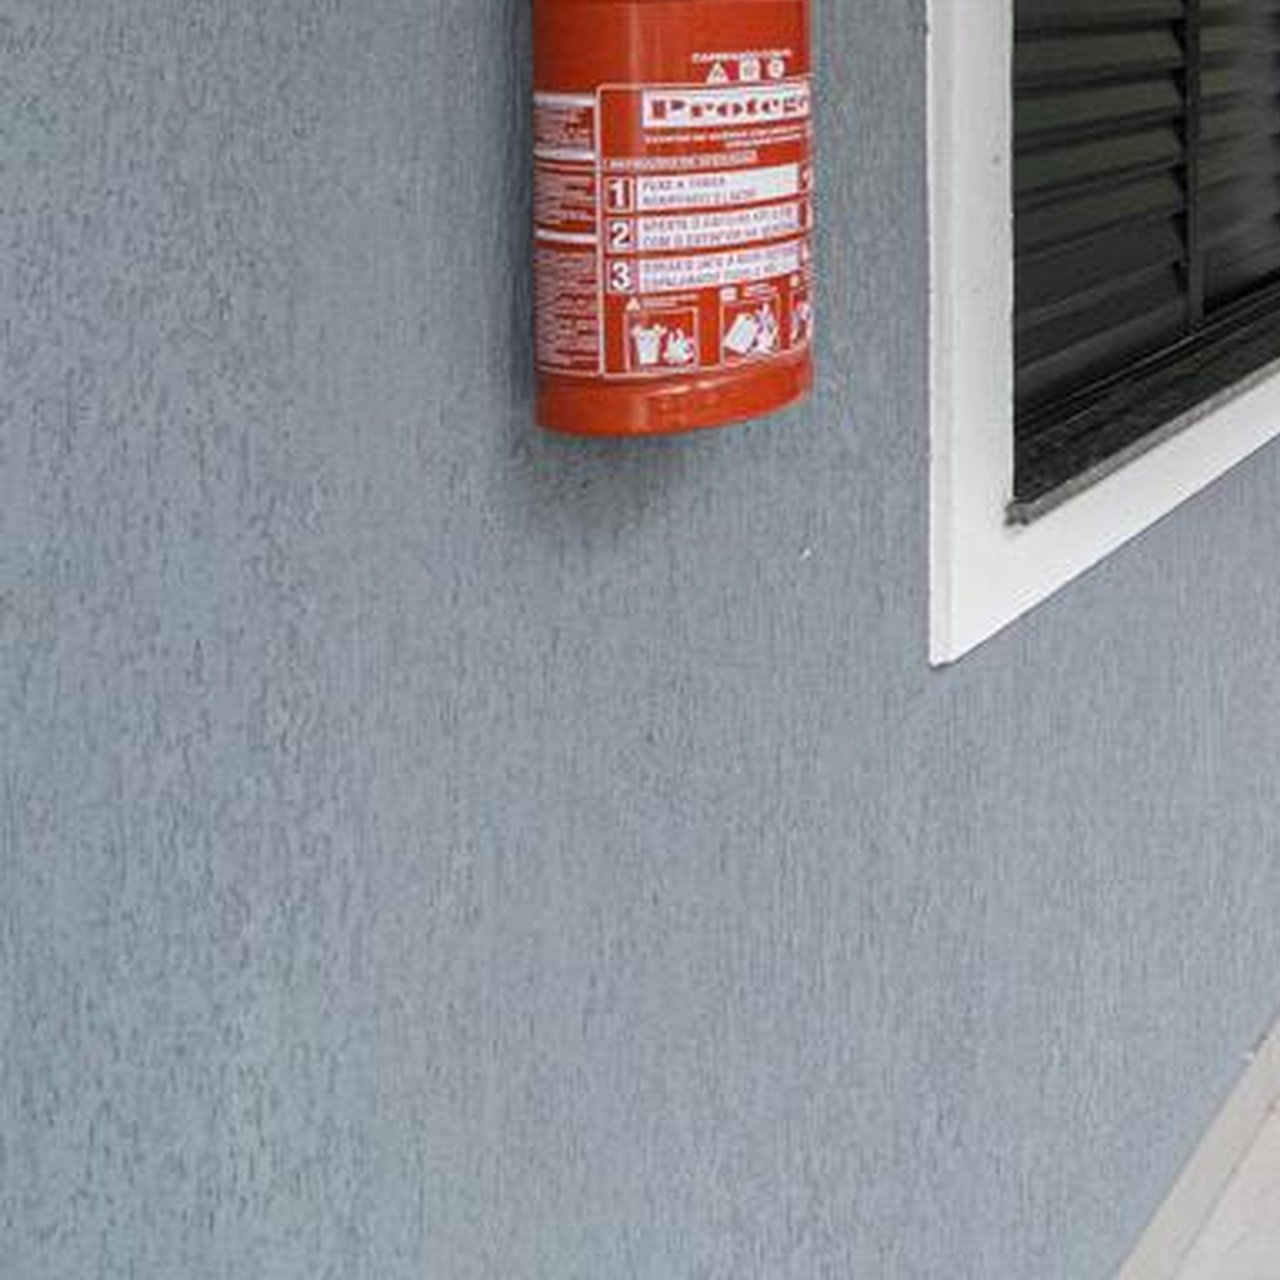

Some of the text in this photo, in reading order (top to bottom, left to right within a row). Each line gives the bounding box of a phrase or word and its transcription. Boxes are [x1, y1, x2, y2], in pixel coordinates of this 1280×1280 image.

[609, 179, 625, 209] 1
[612, 221, 629, 249] 2
[612, 261, 630, 293] 3
